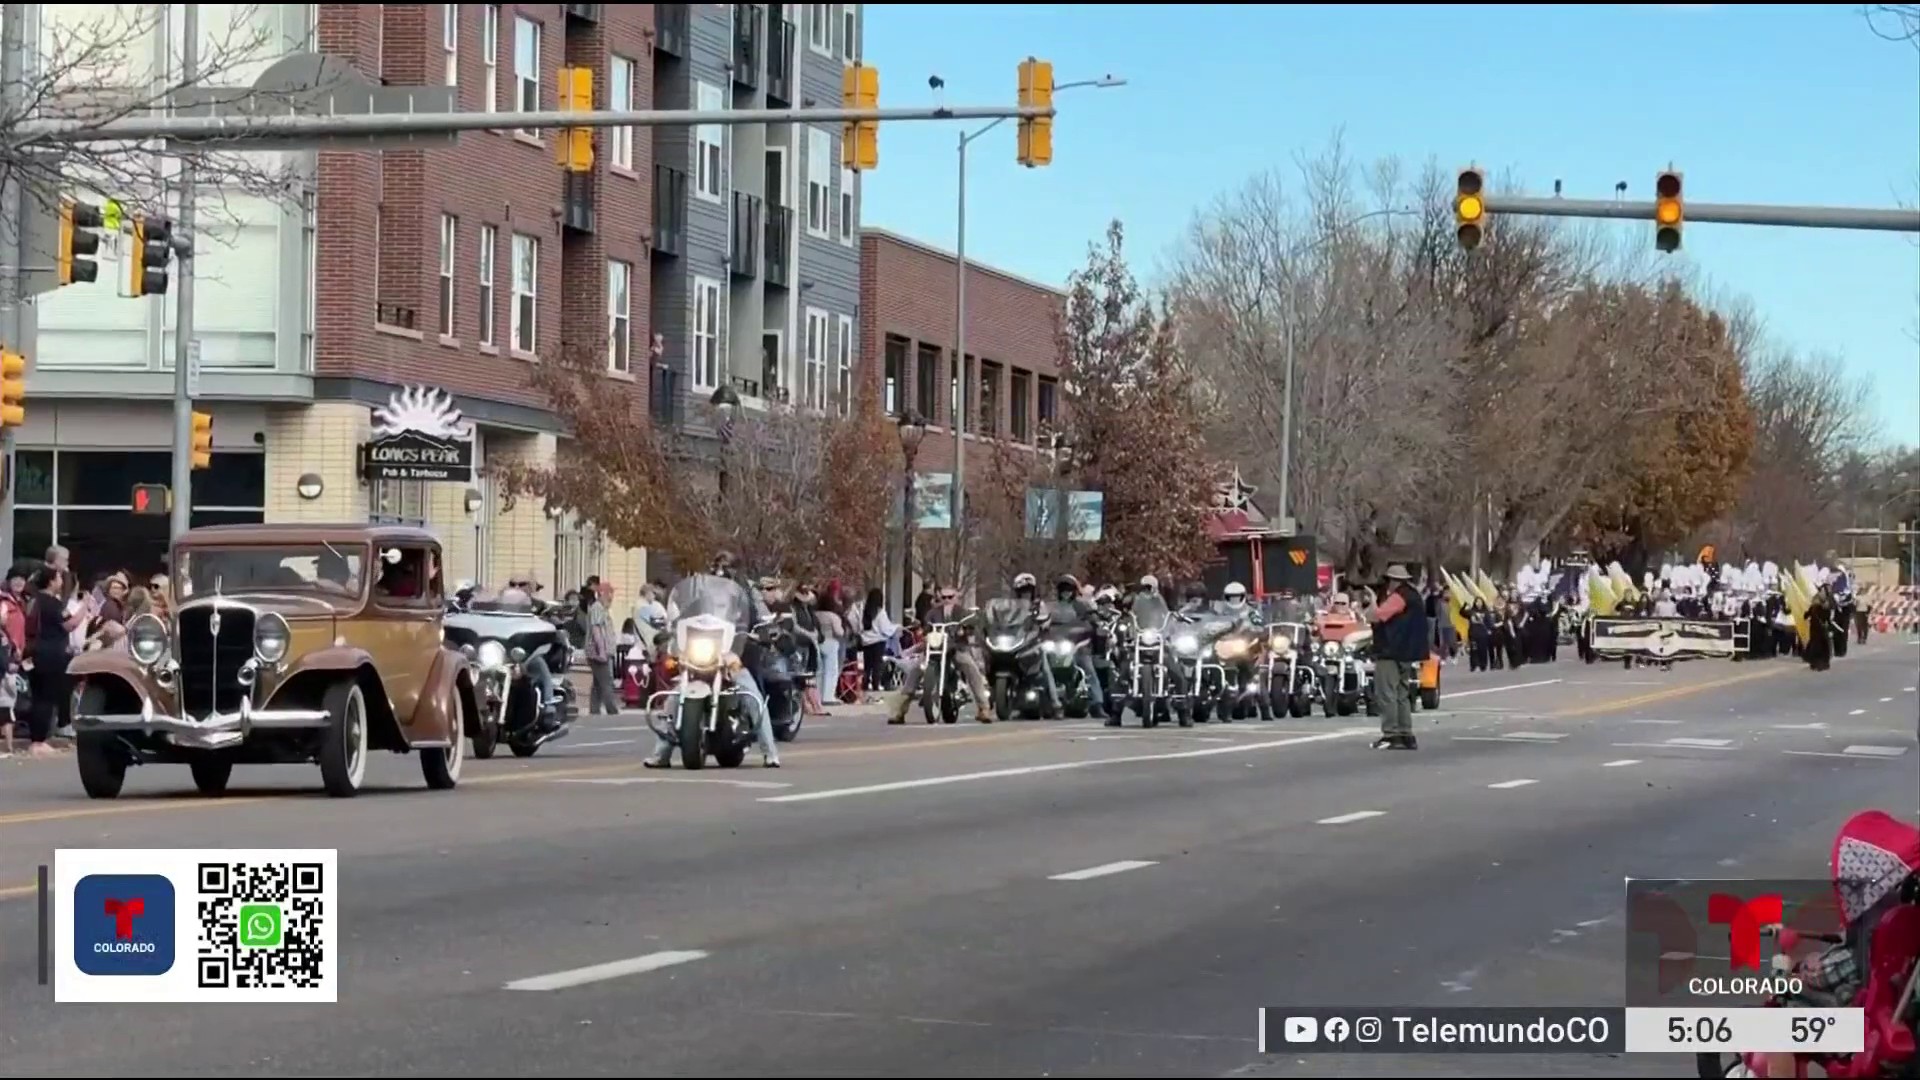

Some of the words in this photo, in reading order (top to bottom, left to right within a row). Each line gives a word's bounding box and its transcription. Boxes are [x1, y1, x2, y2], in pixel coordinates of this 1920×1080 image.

[421, 448, 460, 464] PEAK
[382, 467, 398, 477] Pub
[400, 468, 408, 477] &
